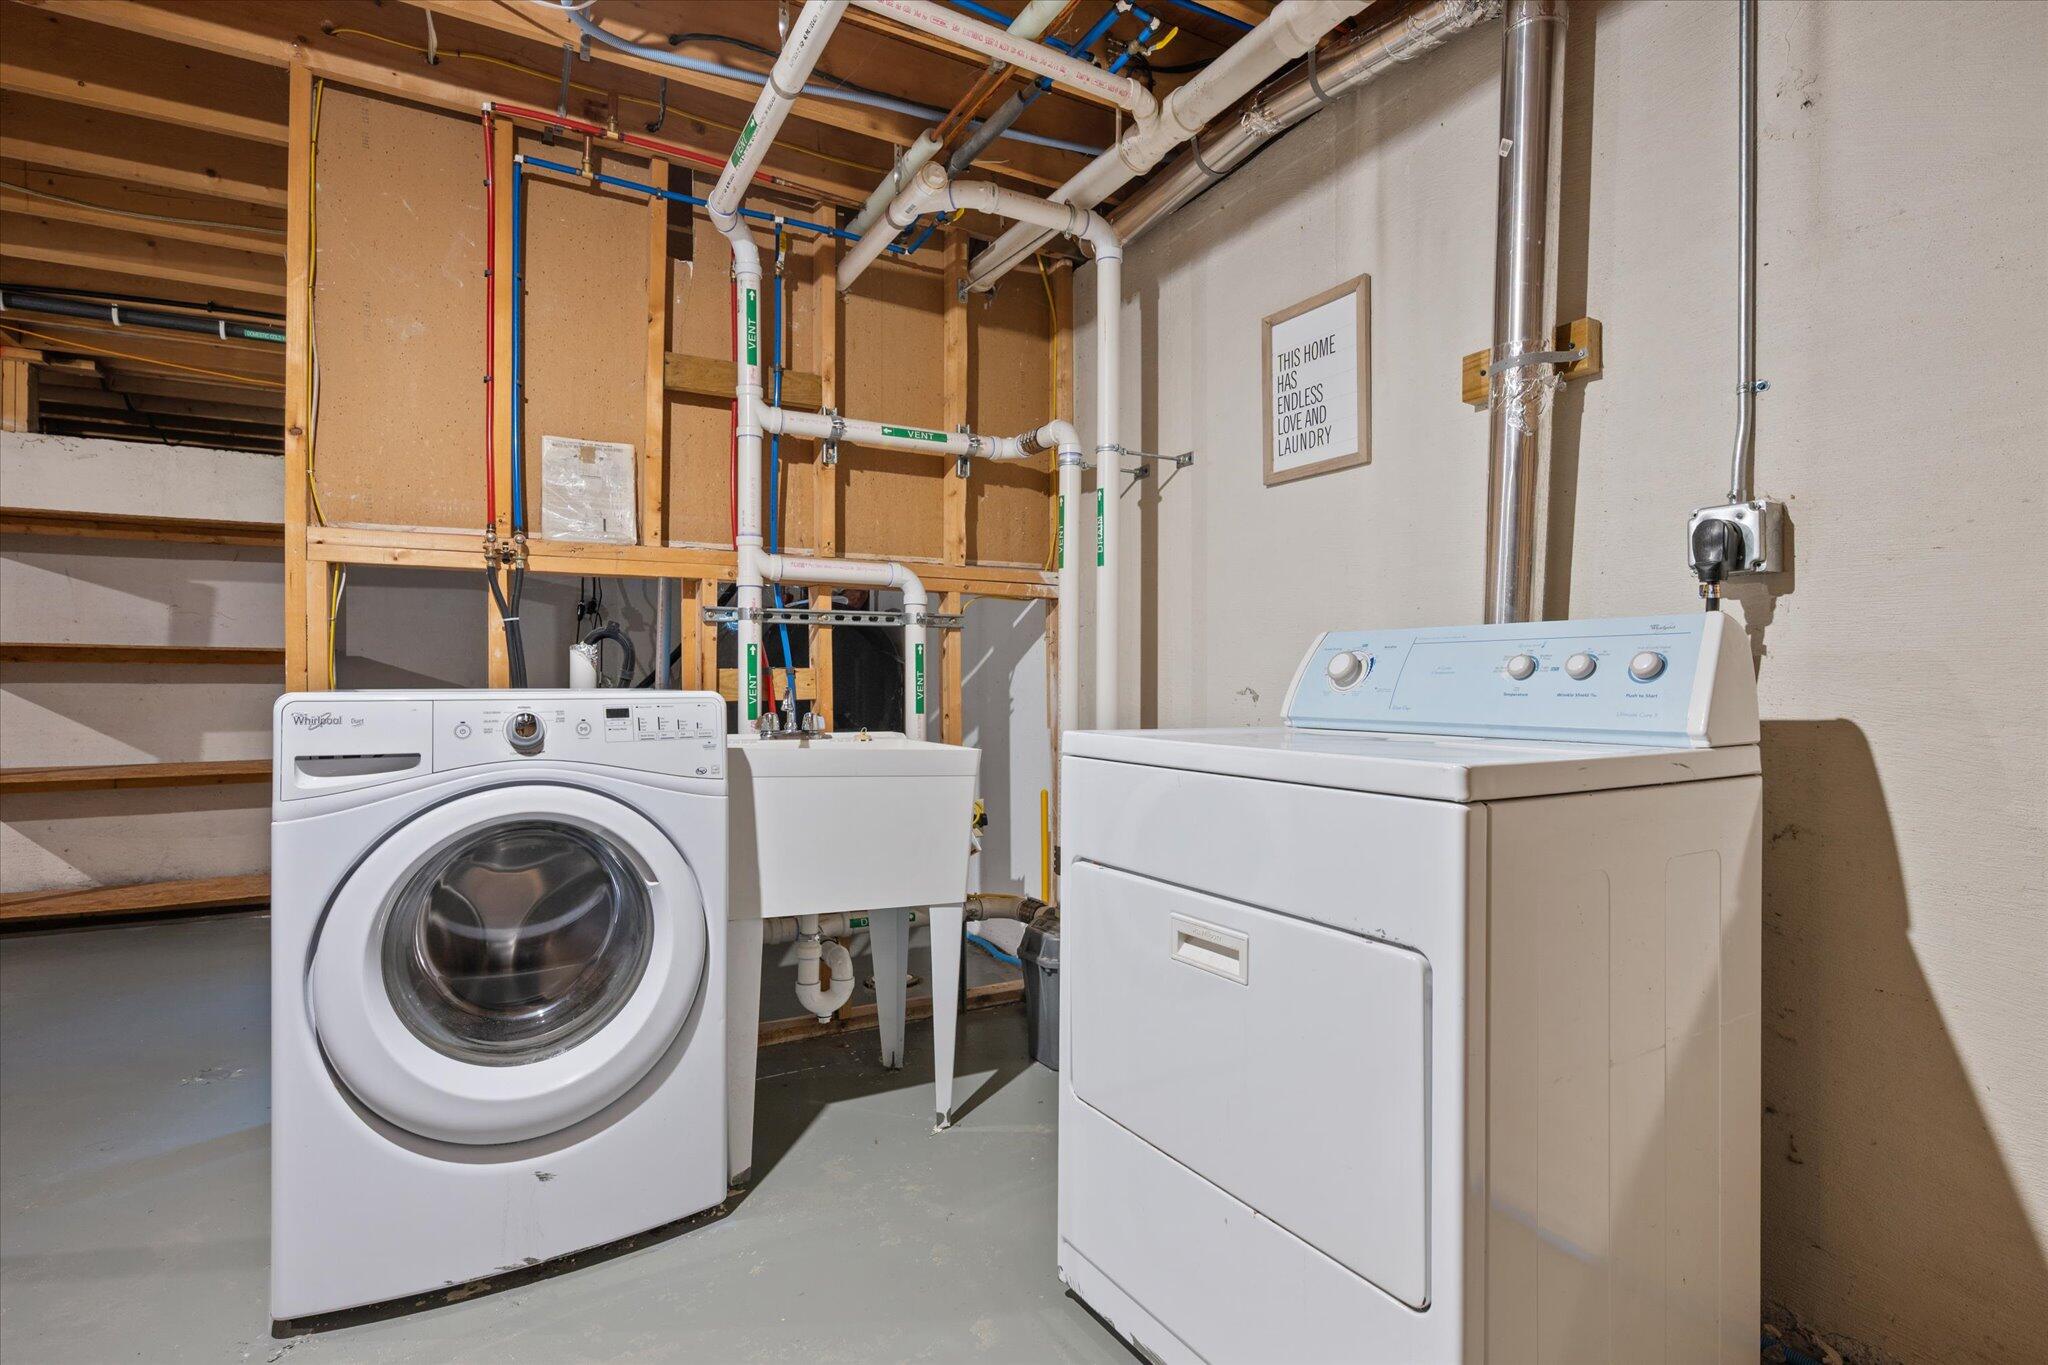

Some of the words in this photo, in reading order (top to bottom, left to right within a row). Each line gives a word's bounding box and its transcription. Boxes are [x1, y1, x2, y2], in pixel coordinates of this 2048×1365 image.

[748, 317, 756, 349] VENT
[1278, 347, 1301, 372] THIS
[1304, 334, 1336, 363] HOME
[1277, 370, 1298, 394] HAS
[1277, 383, 1324, 415] ENDLESS
[907, 430, 935, 440] VENT
[1278, 411, 1303, 436] LOVE
[1304, 405, 1327, 428] AND
[1278, 425, 1333, 457] LAUNDRY
[748, 673, 757, 705] VENT
[916, 670, 924, 700] VENT
[293, 714, 343, 729] Whirlpool
